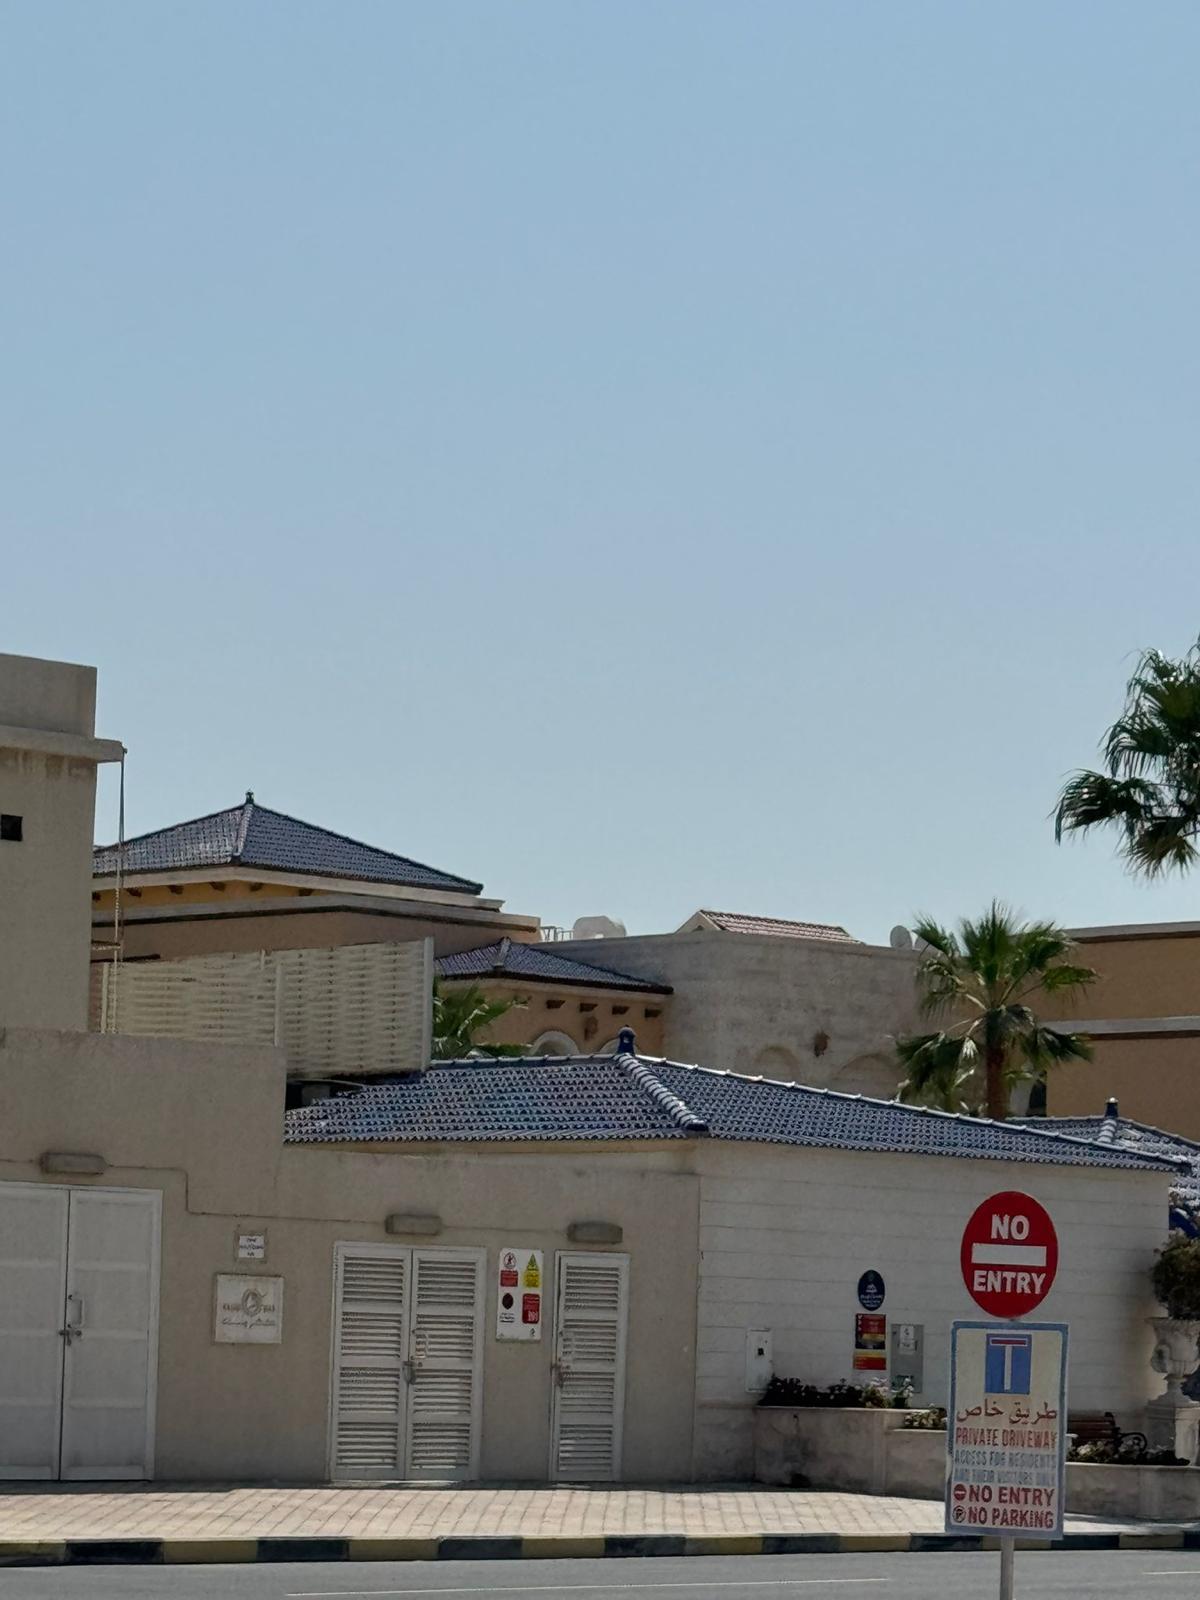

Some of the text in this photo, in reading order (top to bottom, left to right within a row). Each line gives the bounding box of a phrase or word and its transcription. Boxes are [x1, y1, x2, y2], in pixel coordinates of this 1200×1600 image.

[991, 1214, 1030, 1240] NO
[973, 1270, 1046, 1294] ENTRY
[957, 1398, 1058, 1425] طريق خاص
[955, 1427, 1058, 1449] PRIVATE DRIVEWAY
[955, 1449, 987, 1466] ACCESS
[968, 1484, 1055, 1507] NO ENTRY
[968, 1506, 1054, 1529] NO PARKING
